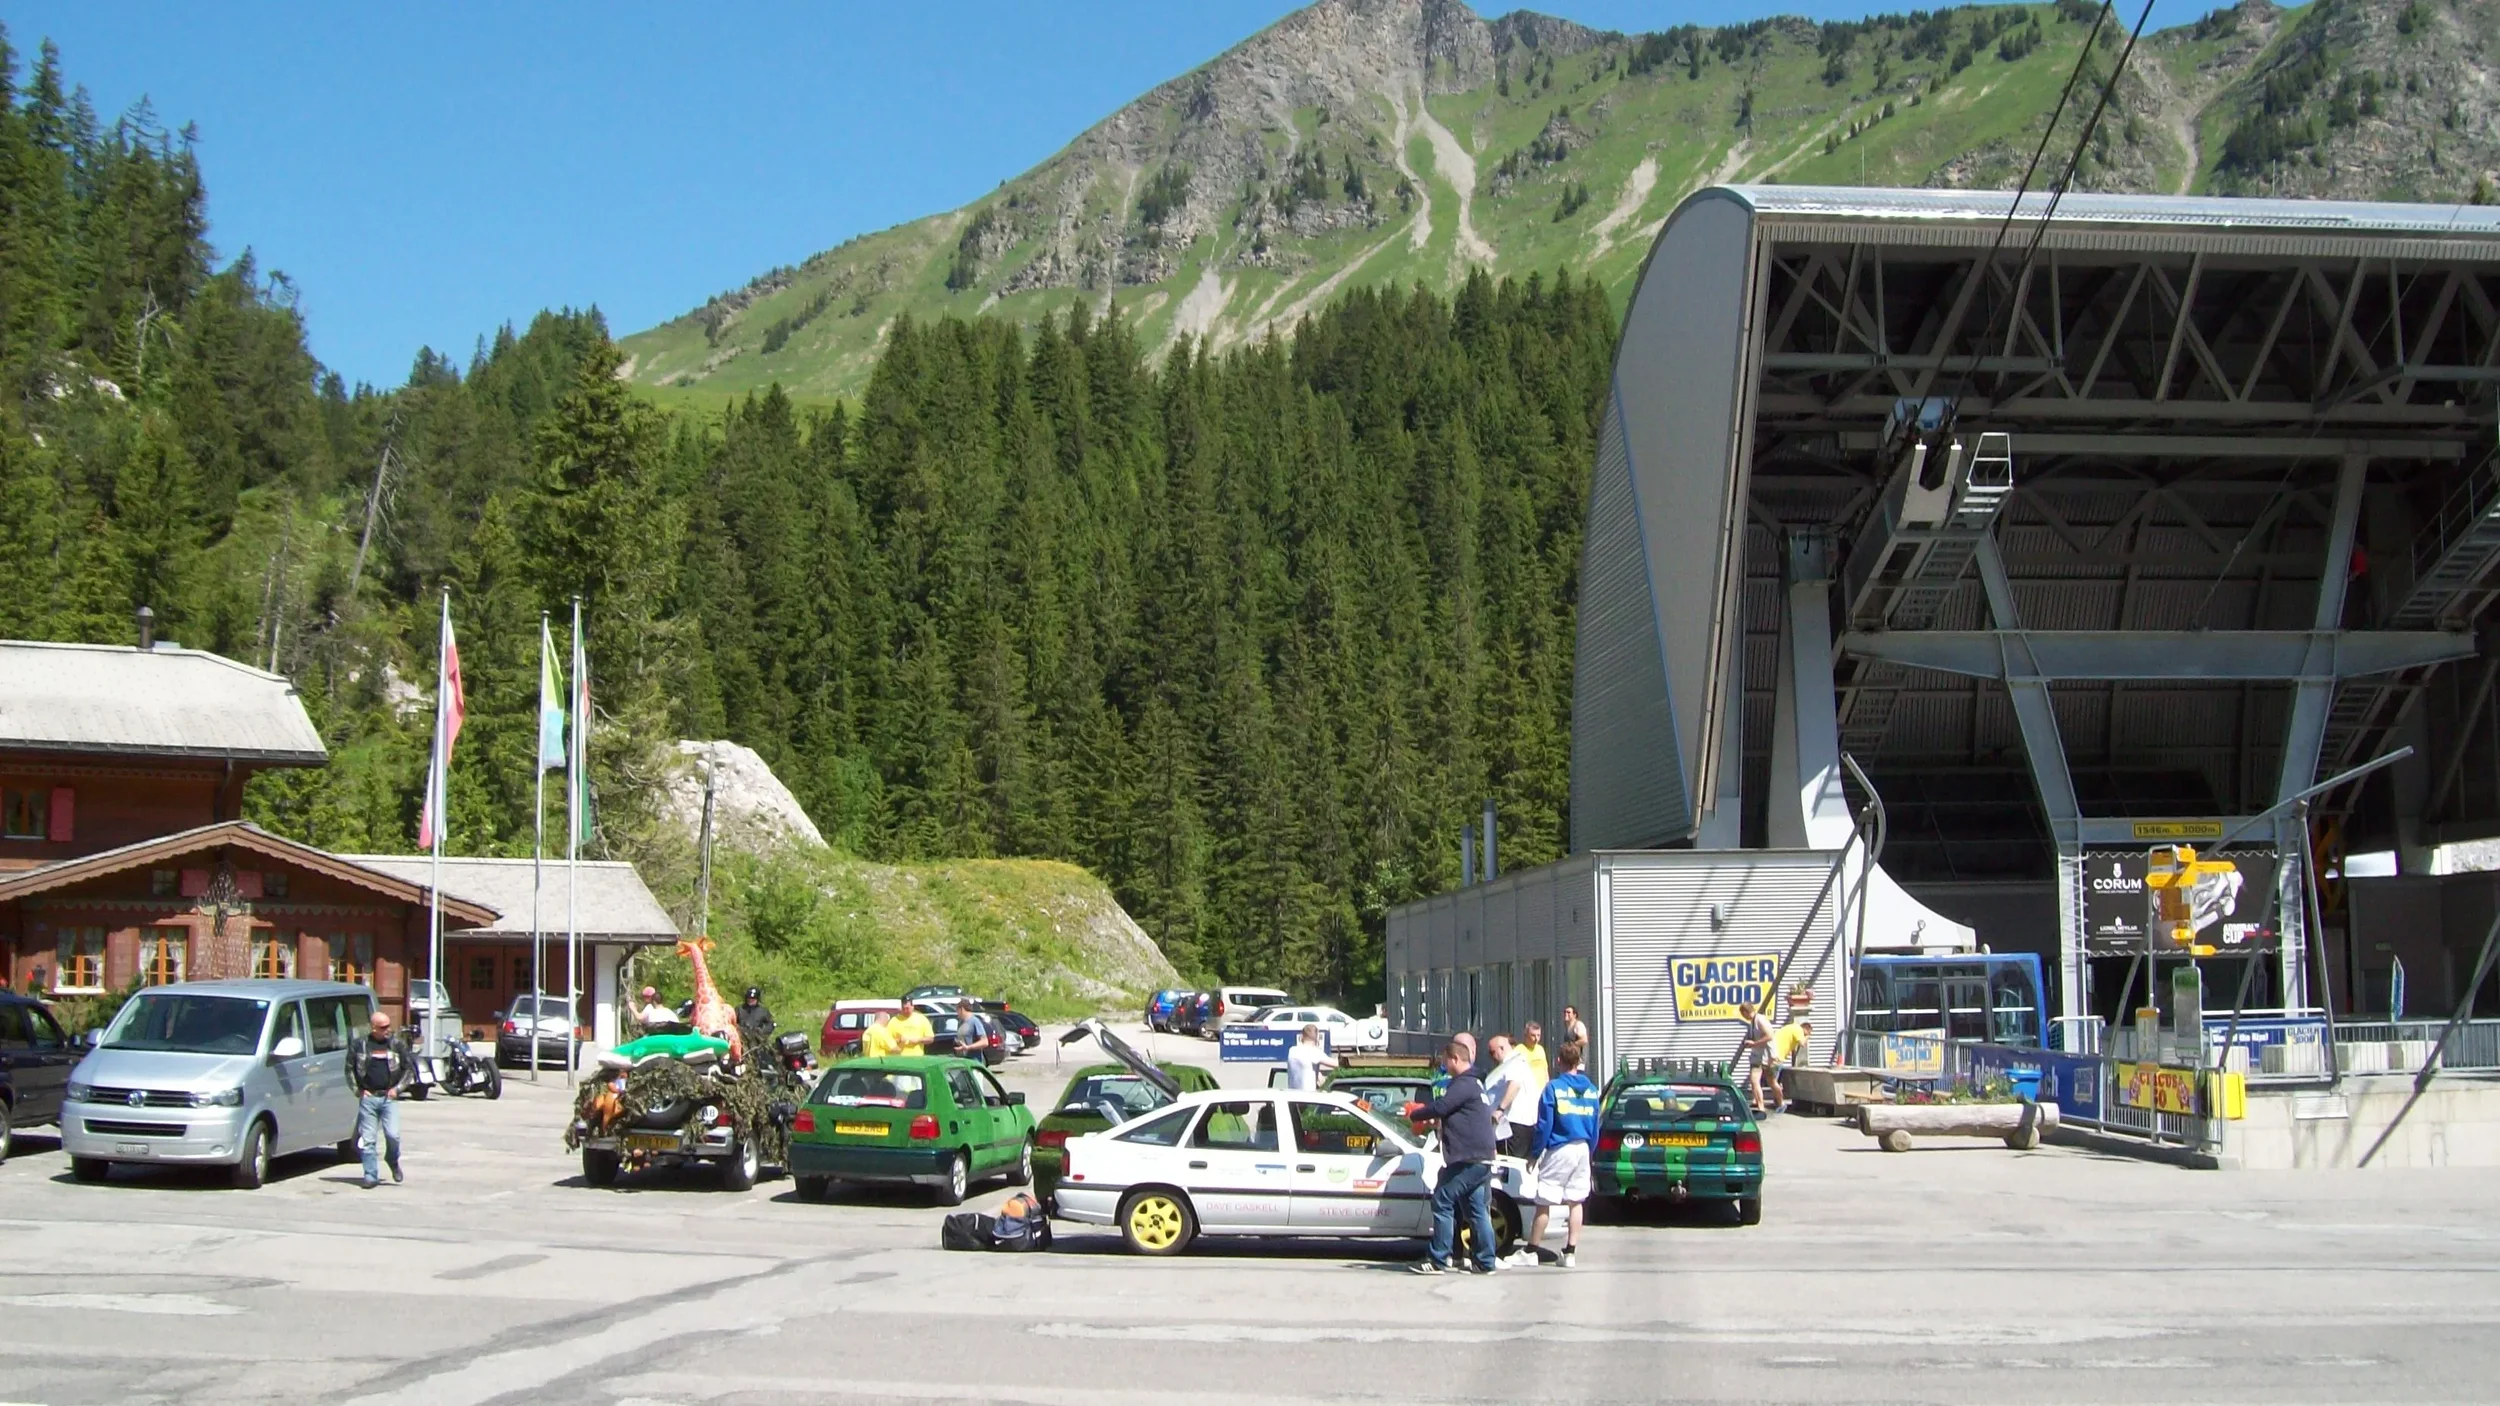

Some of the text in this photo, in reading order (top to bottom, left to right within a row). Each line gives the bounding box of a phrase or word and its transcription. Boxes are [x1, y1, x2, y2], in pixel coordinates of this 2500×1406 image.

[2093, 878, 2142, 890] CORUM
[1677, 958, 1776, 987] GLACIER
[1693, 983, 1762, 1007] 3000
[1205, 1201, 1280, 1213] DAVE GASKELL
[1318, 1206, 1351, 1217] STEVE
